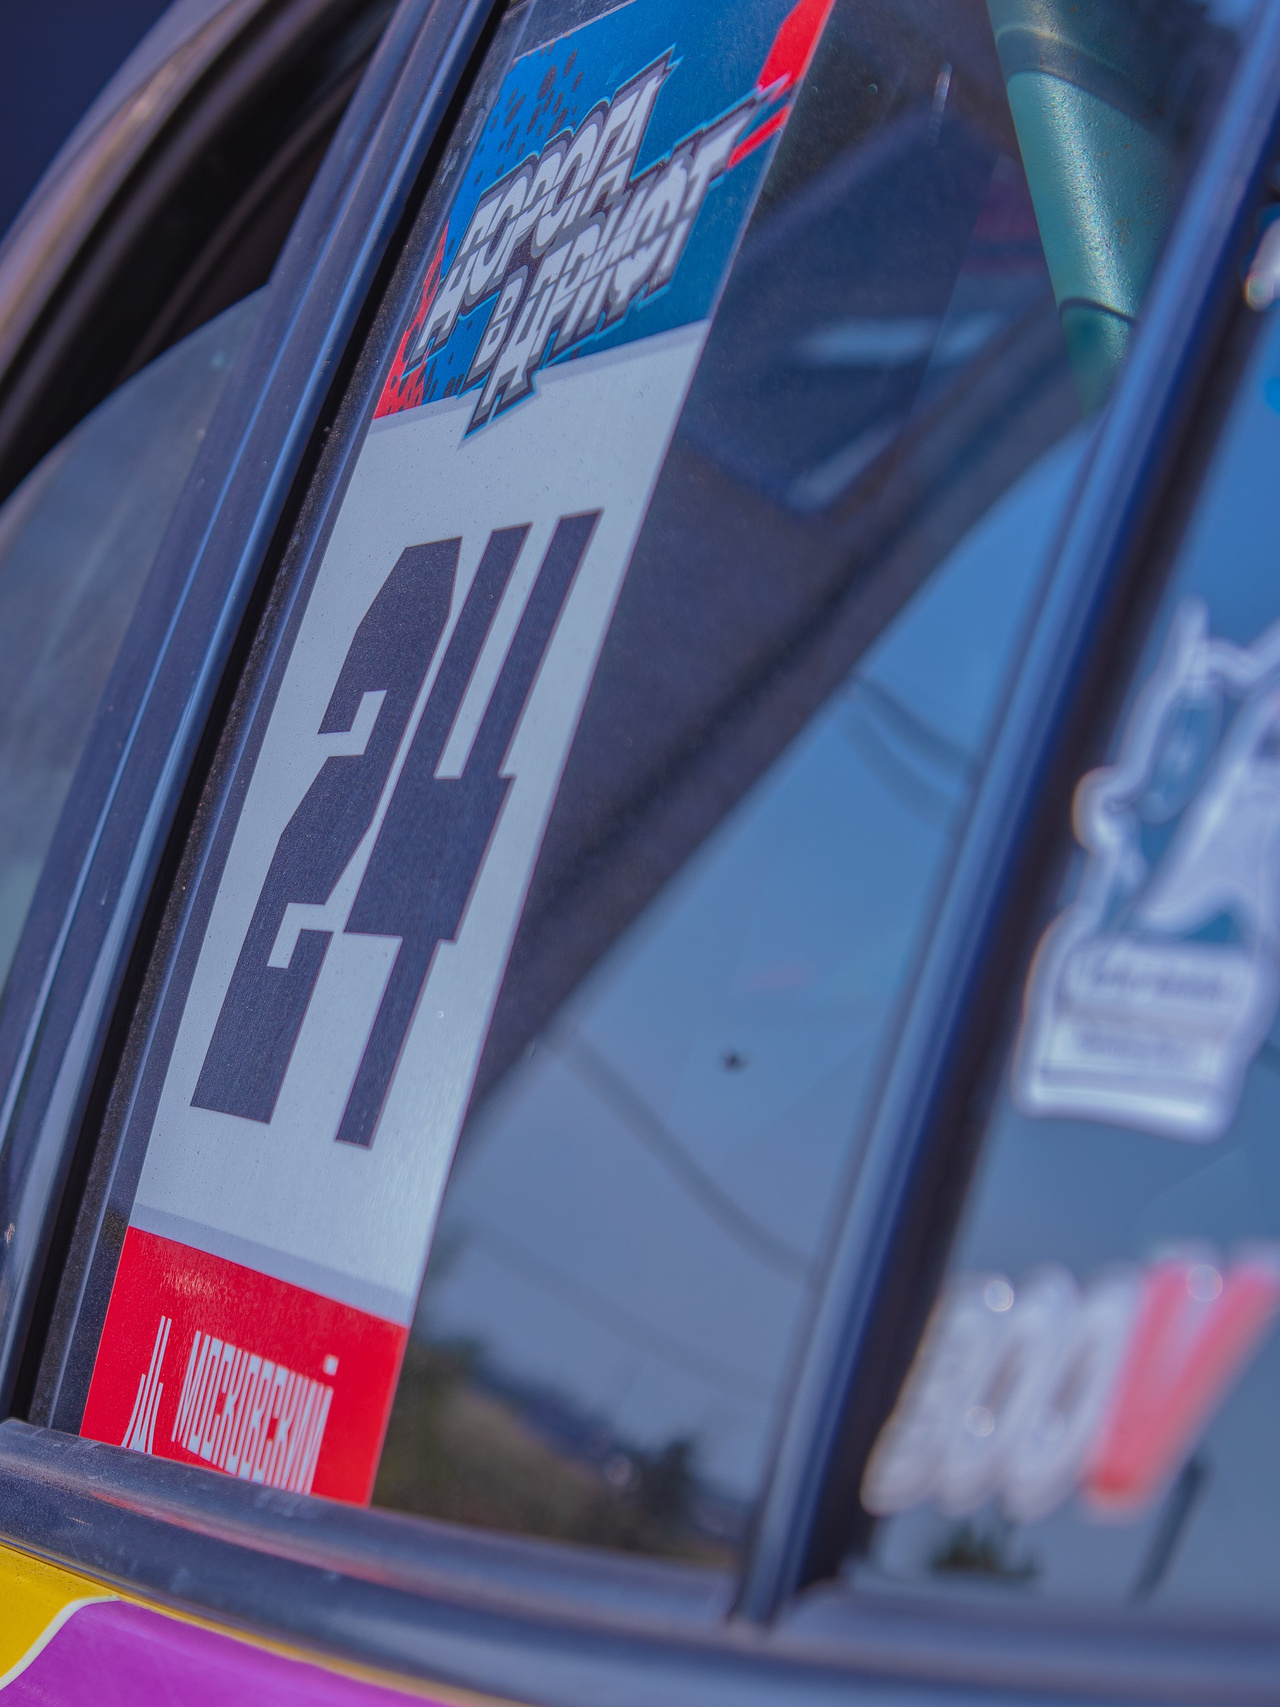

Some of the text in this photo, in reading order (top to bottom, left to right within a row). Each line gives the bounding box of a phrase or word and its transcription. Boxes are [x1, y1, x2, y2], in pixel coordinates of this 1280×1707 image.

[413, 72, 668, 354] ДОРОГА
[477, 98, 763, 412] В ДРИФТ
[189, 507, 605, 1151] 24
[170, 1330, 340, 1497] МОСКОВСКИЙ
